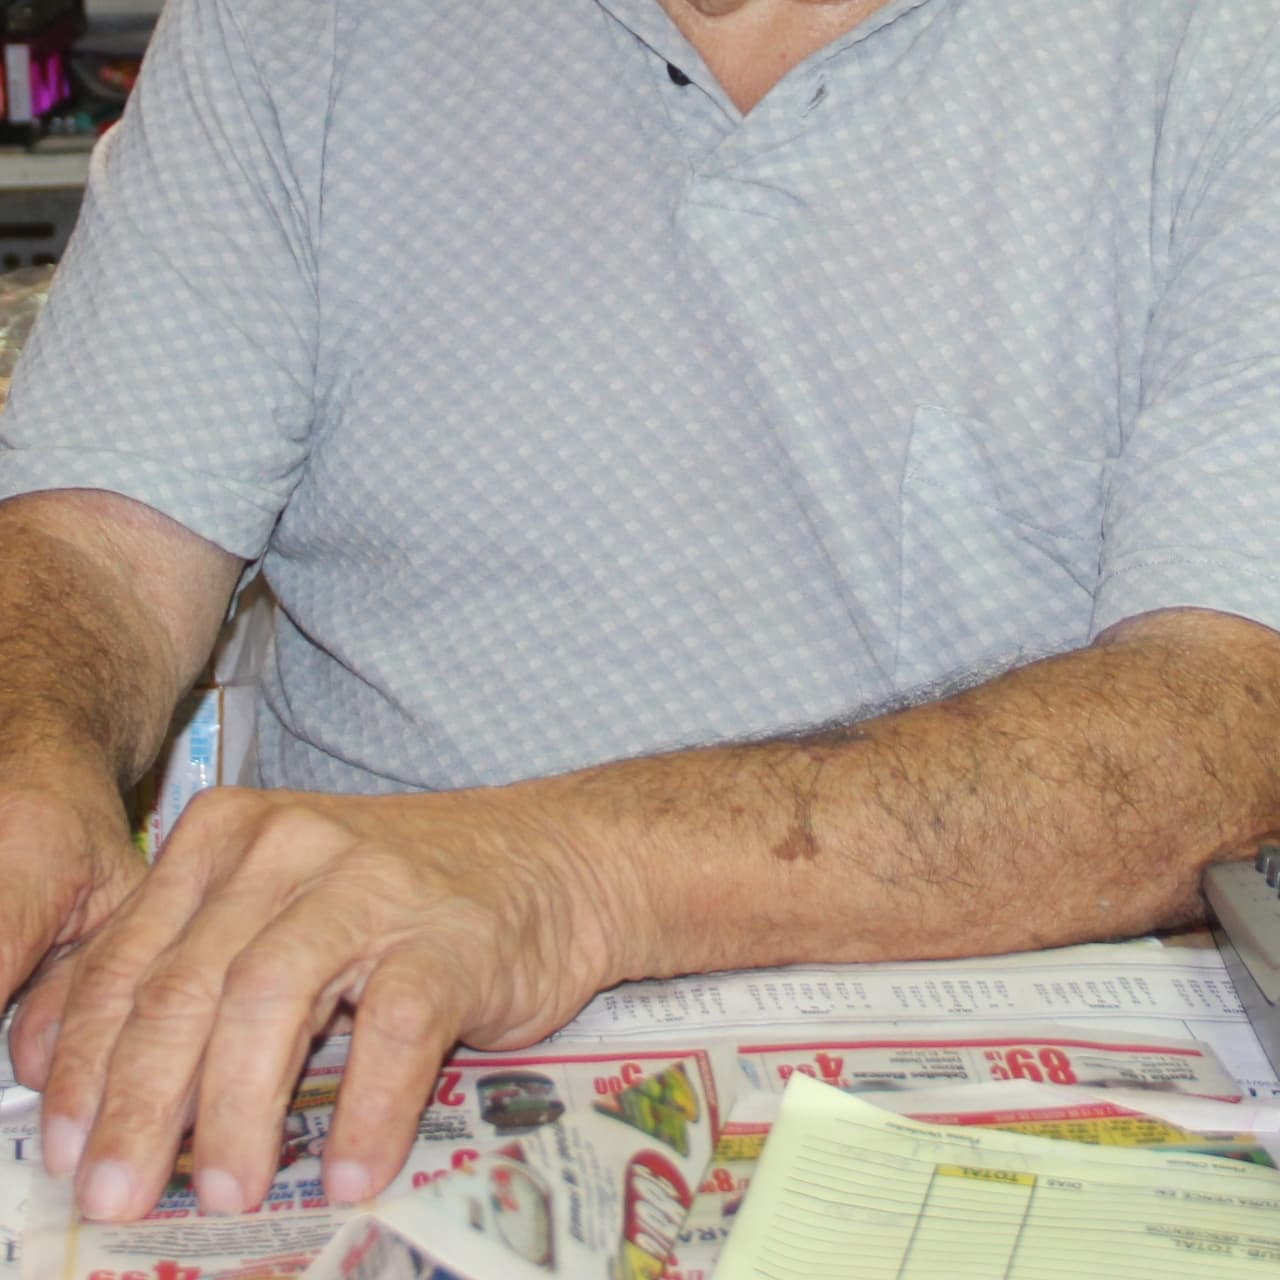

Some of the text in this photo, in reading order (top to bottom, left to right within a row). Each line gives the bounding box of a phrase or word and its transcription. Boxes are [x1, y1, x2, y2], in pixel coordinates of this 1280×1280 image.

[962, 1166, 1018, 1183] TOTAL
[1184, 1191, 1233, 1206] VENCE
[1176, 1239, 1233, 1255] TOTAL
